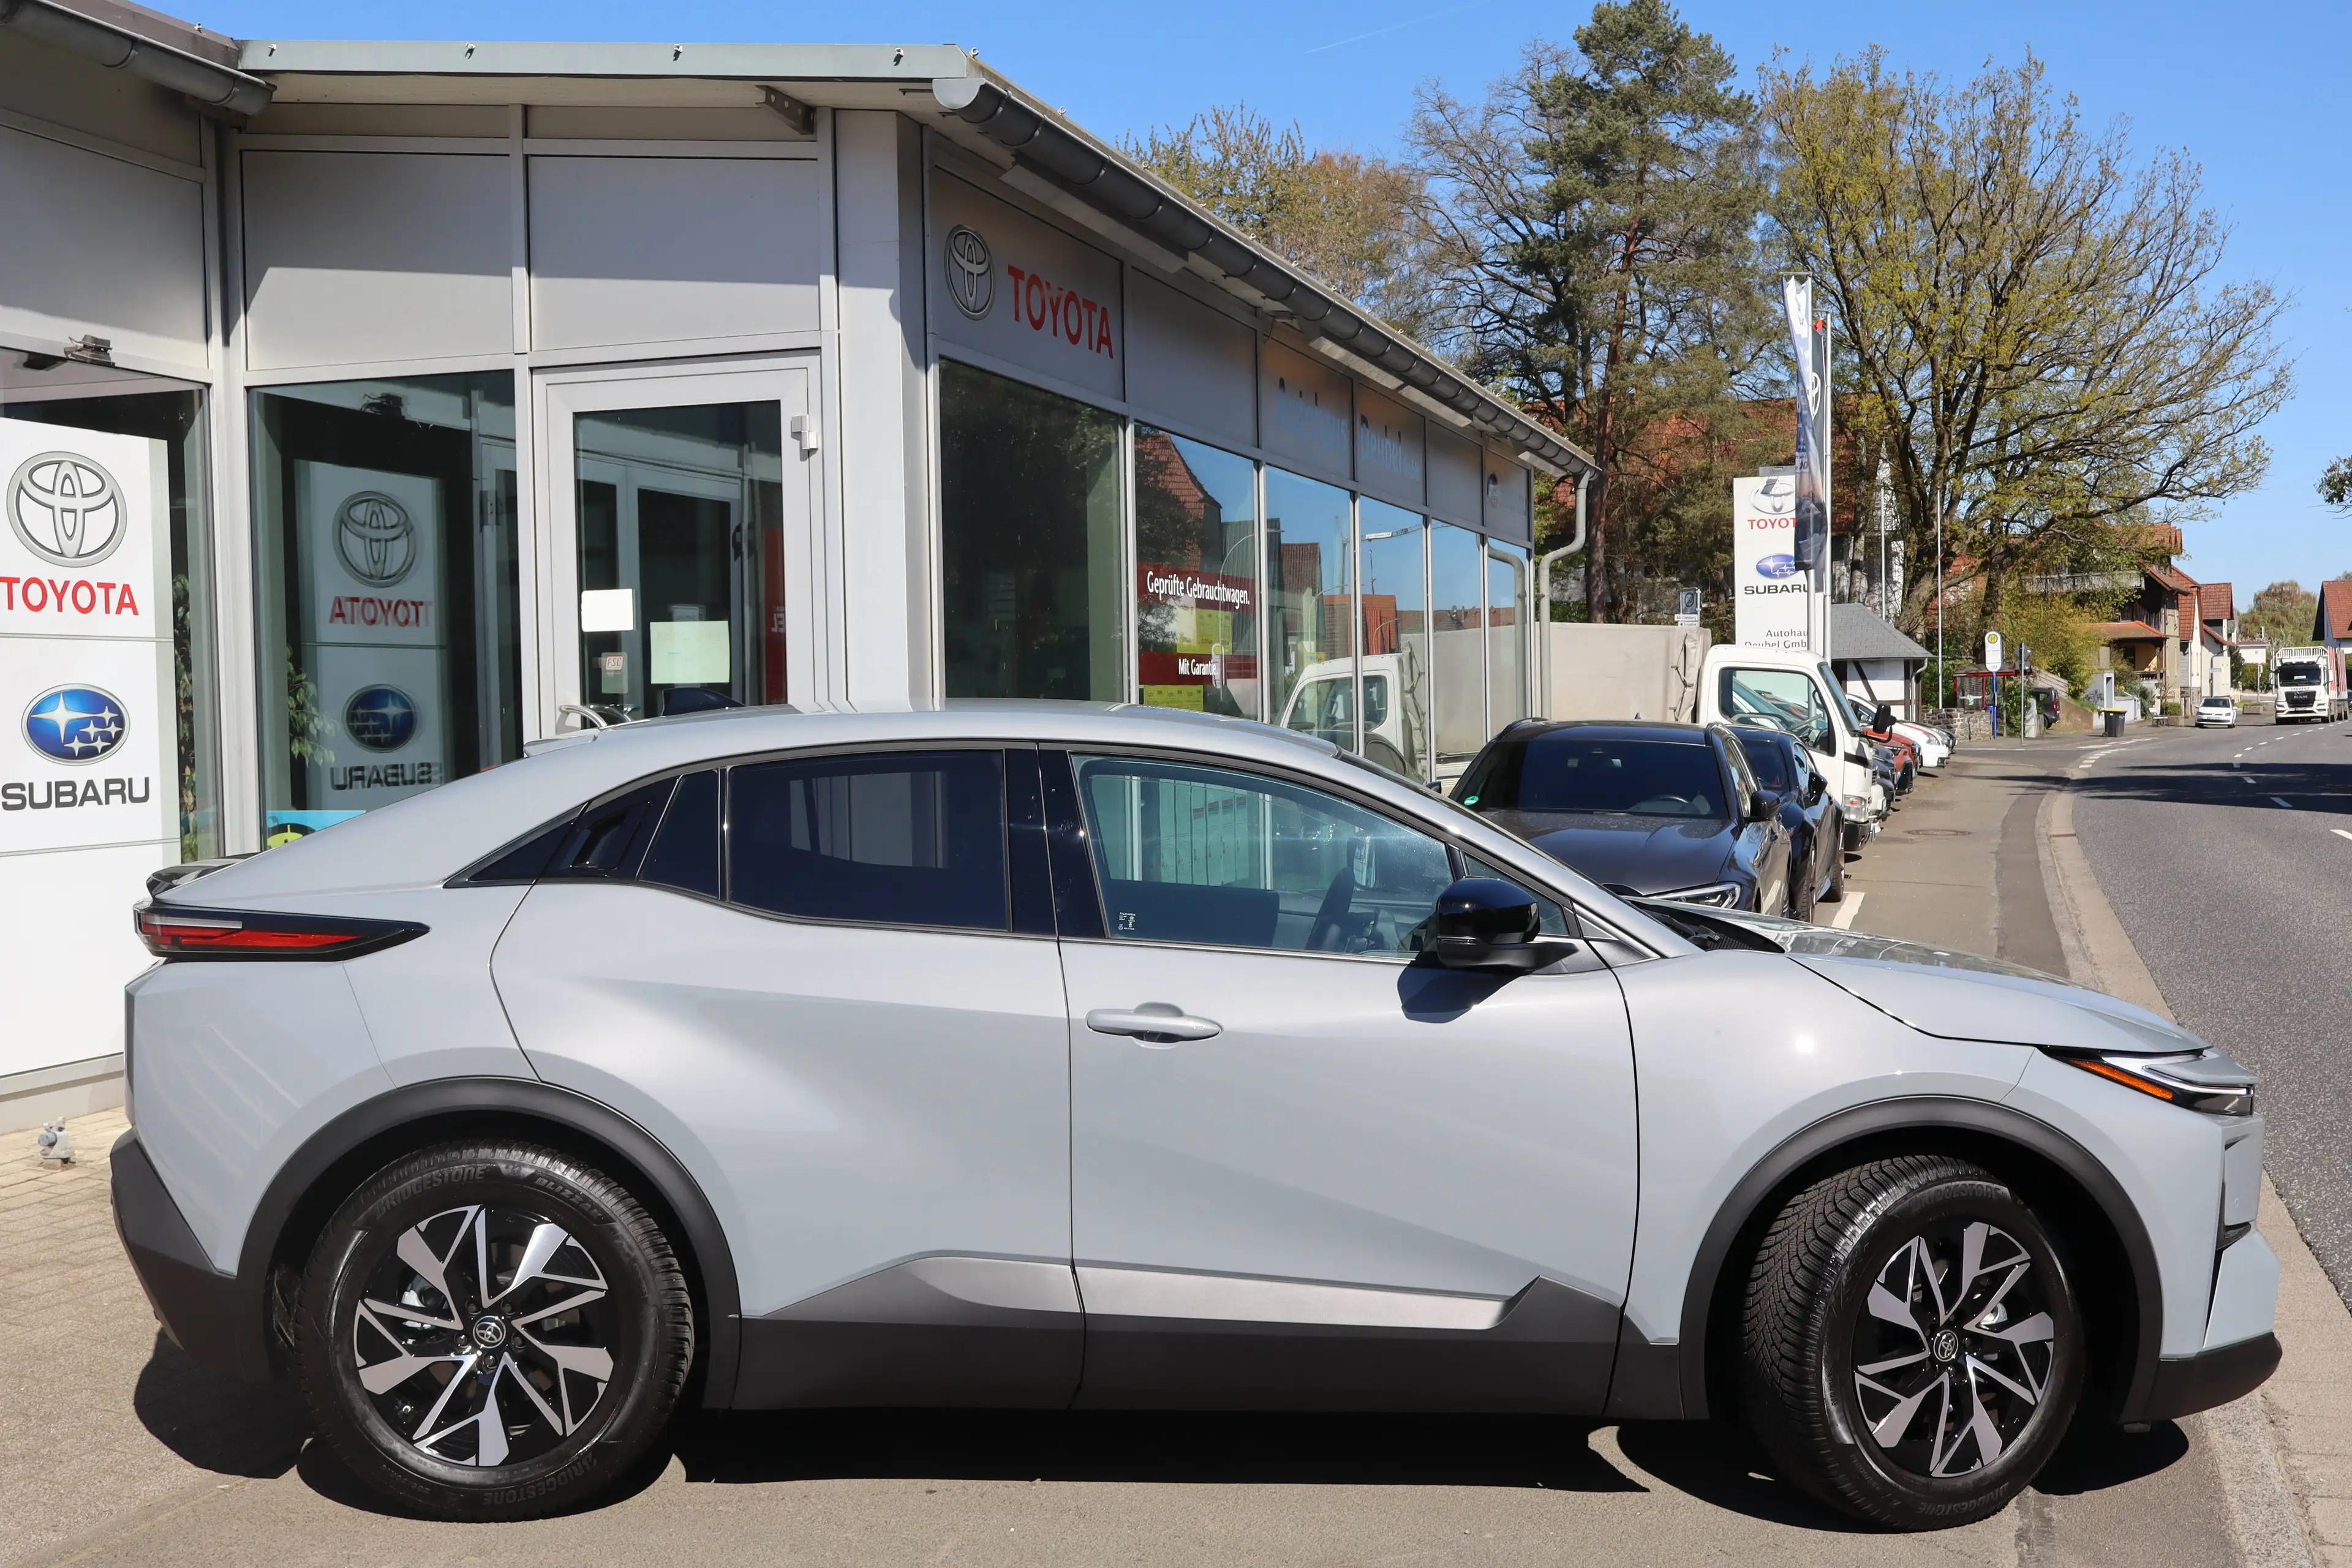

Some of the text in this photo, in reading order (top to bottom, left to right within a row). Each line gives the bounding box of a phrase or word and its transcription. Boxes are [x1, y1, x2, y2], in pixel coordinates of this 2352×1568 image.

[1008, 265, 1114, 359] TOYOTA
[1747, 518, 1797, 530] TOYOT
[0, 576, 139, 616] TOYOTA
[1147, 571, 1250, 609] Geprüfte Gebrauchtwagen.
[1766, 629, 1807, 638] Autohau
[1784, 639, 1807, 648] Gmb
[1178, 658, 1190, 675] Mit
[1191, 659, 1218, 676] Garantie.
[1, 777, 149, 810] SUBARU
[373, 1166, 488, 1221] BRIDGESTONE
[483, 1453, 598, 1506] BRIDGESTONE
